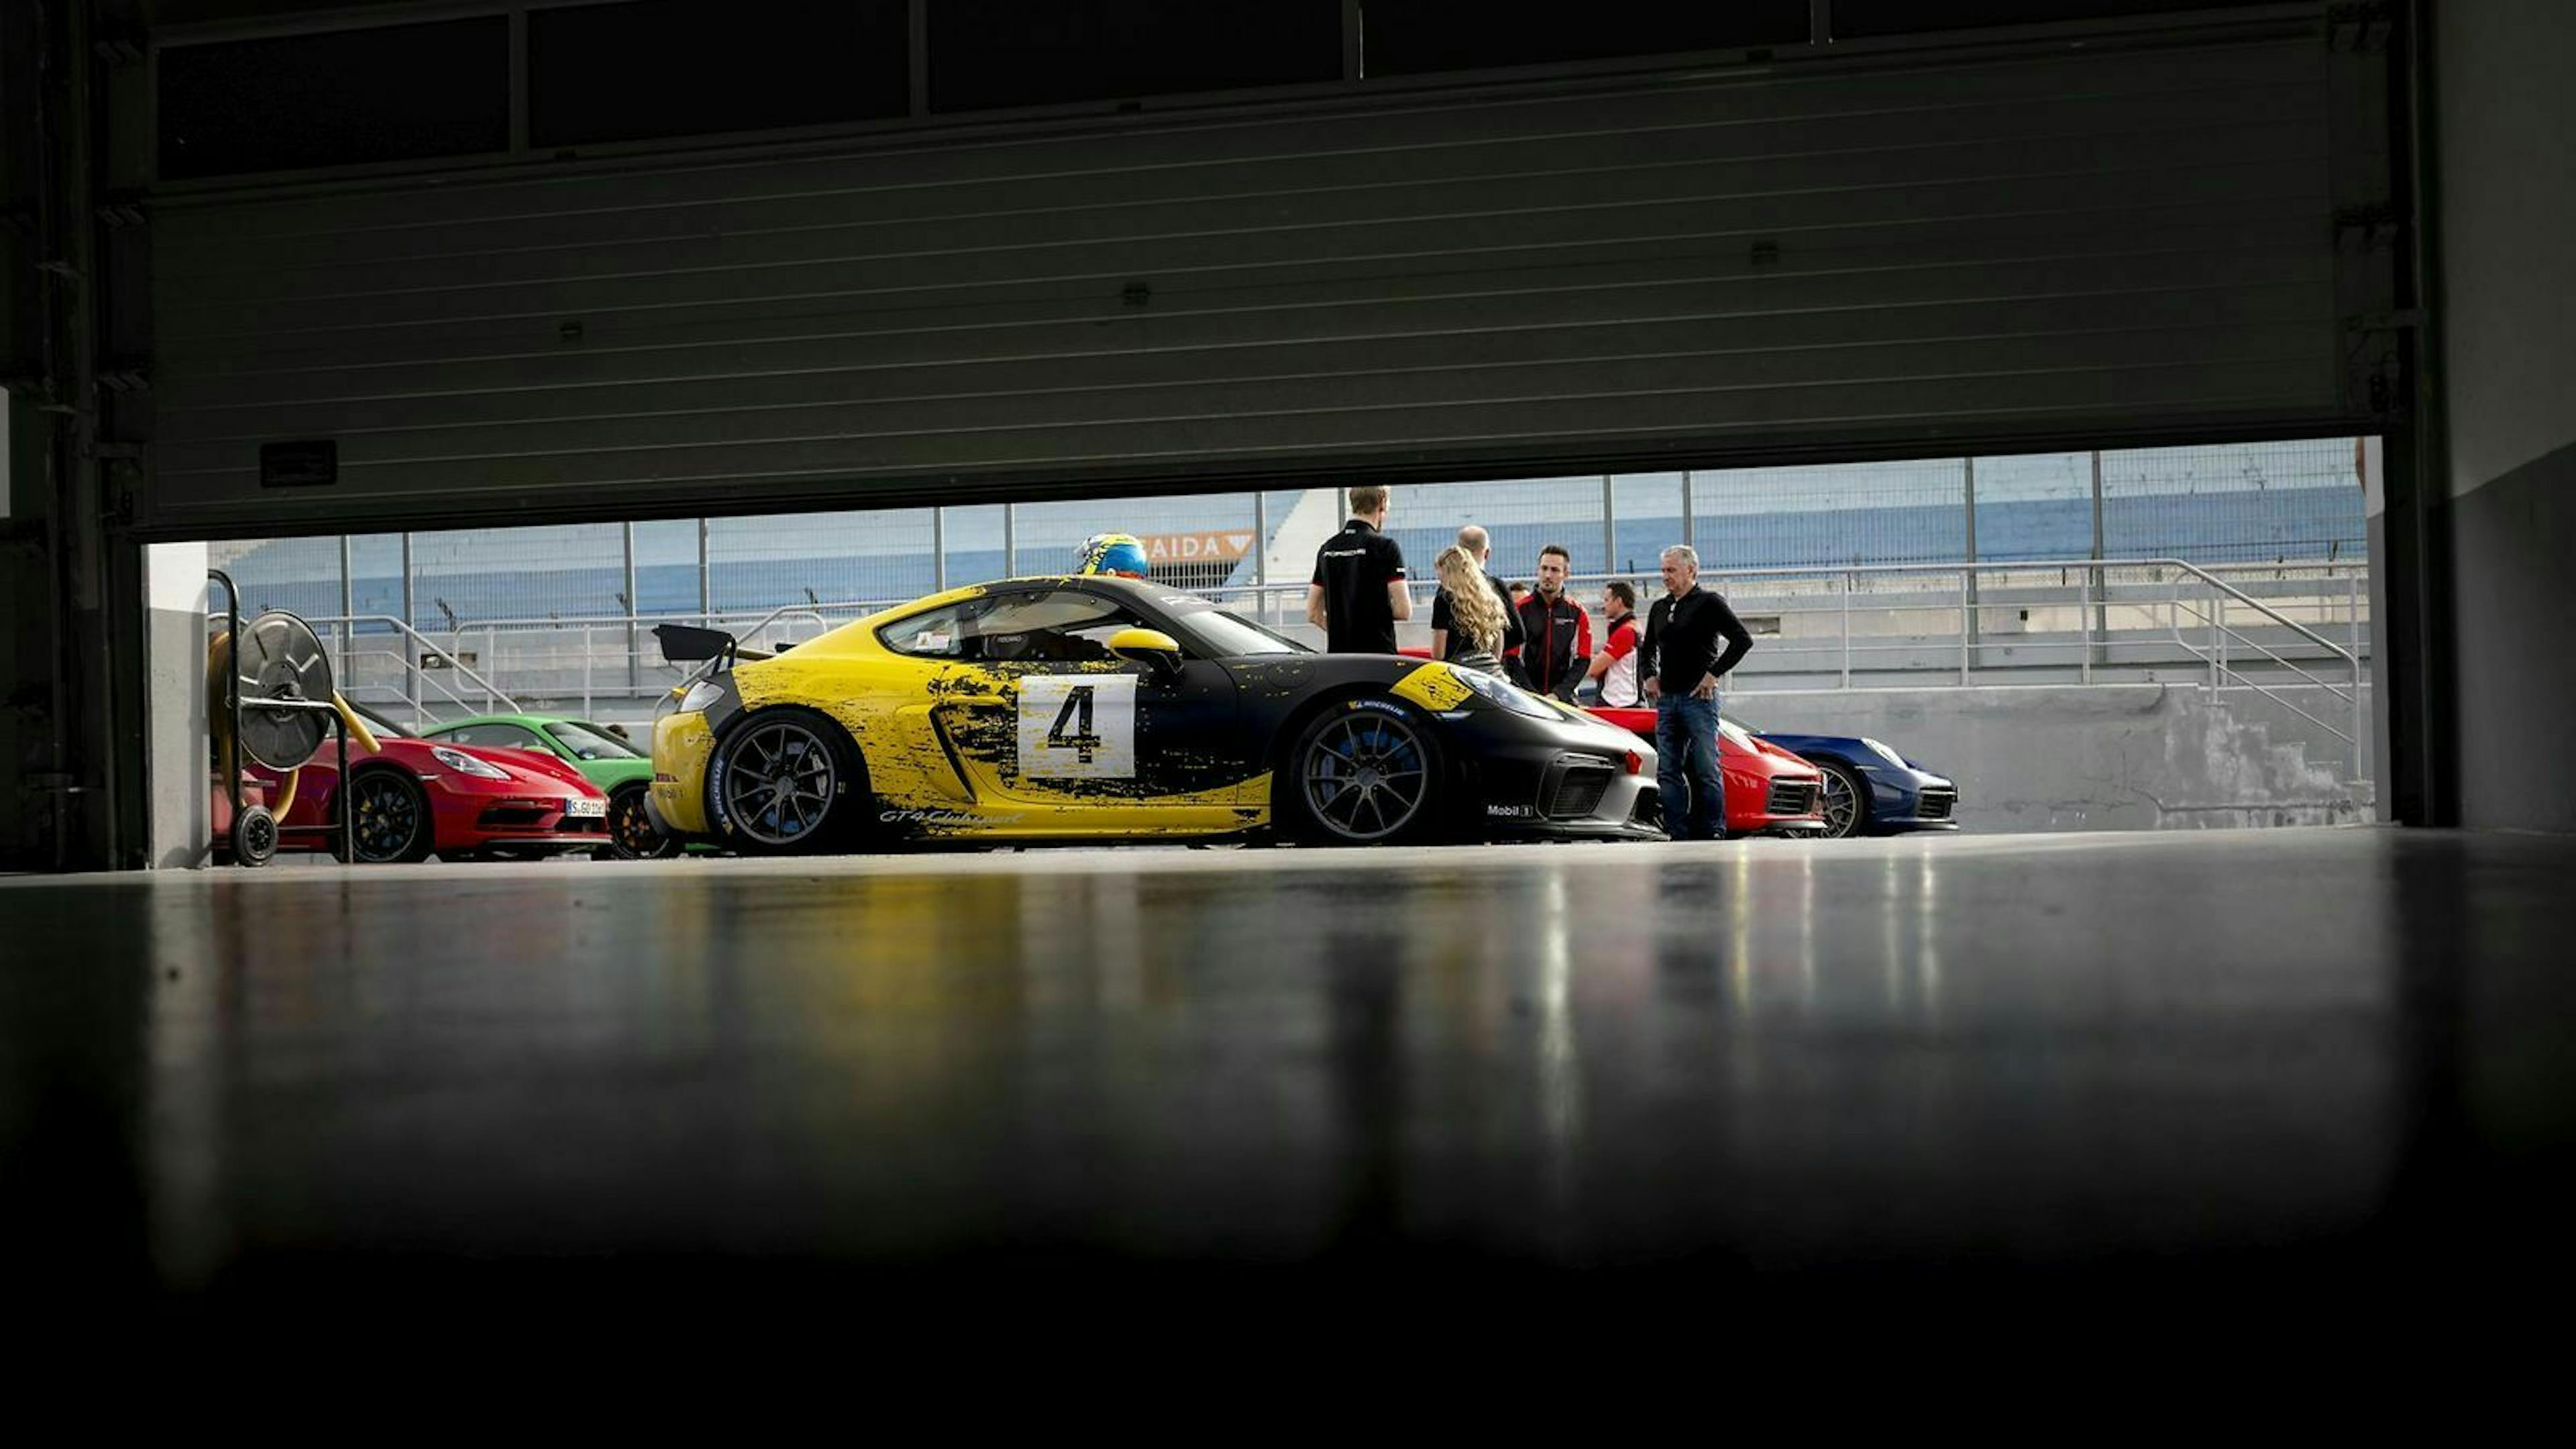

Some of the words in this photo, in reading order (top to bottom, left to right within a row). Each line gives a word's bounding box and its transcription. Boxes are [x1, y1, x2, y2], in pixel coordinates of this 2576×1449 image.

[1150, 537, 1220, 558] AIDA
[1048, 686, 1101, 763] 4
[1487, 804, 1519, 816] Mobil
